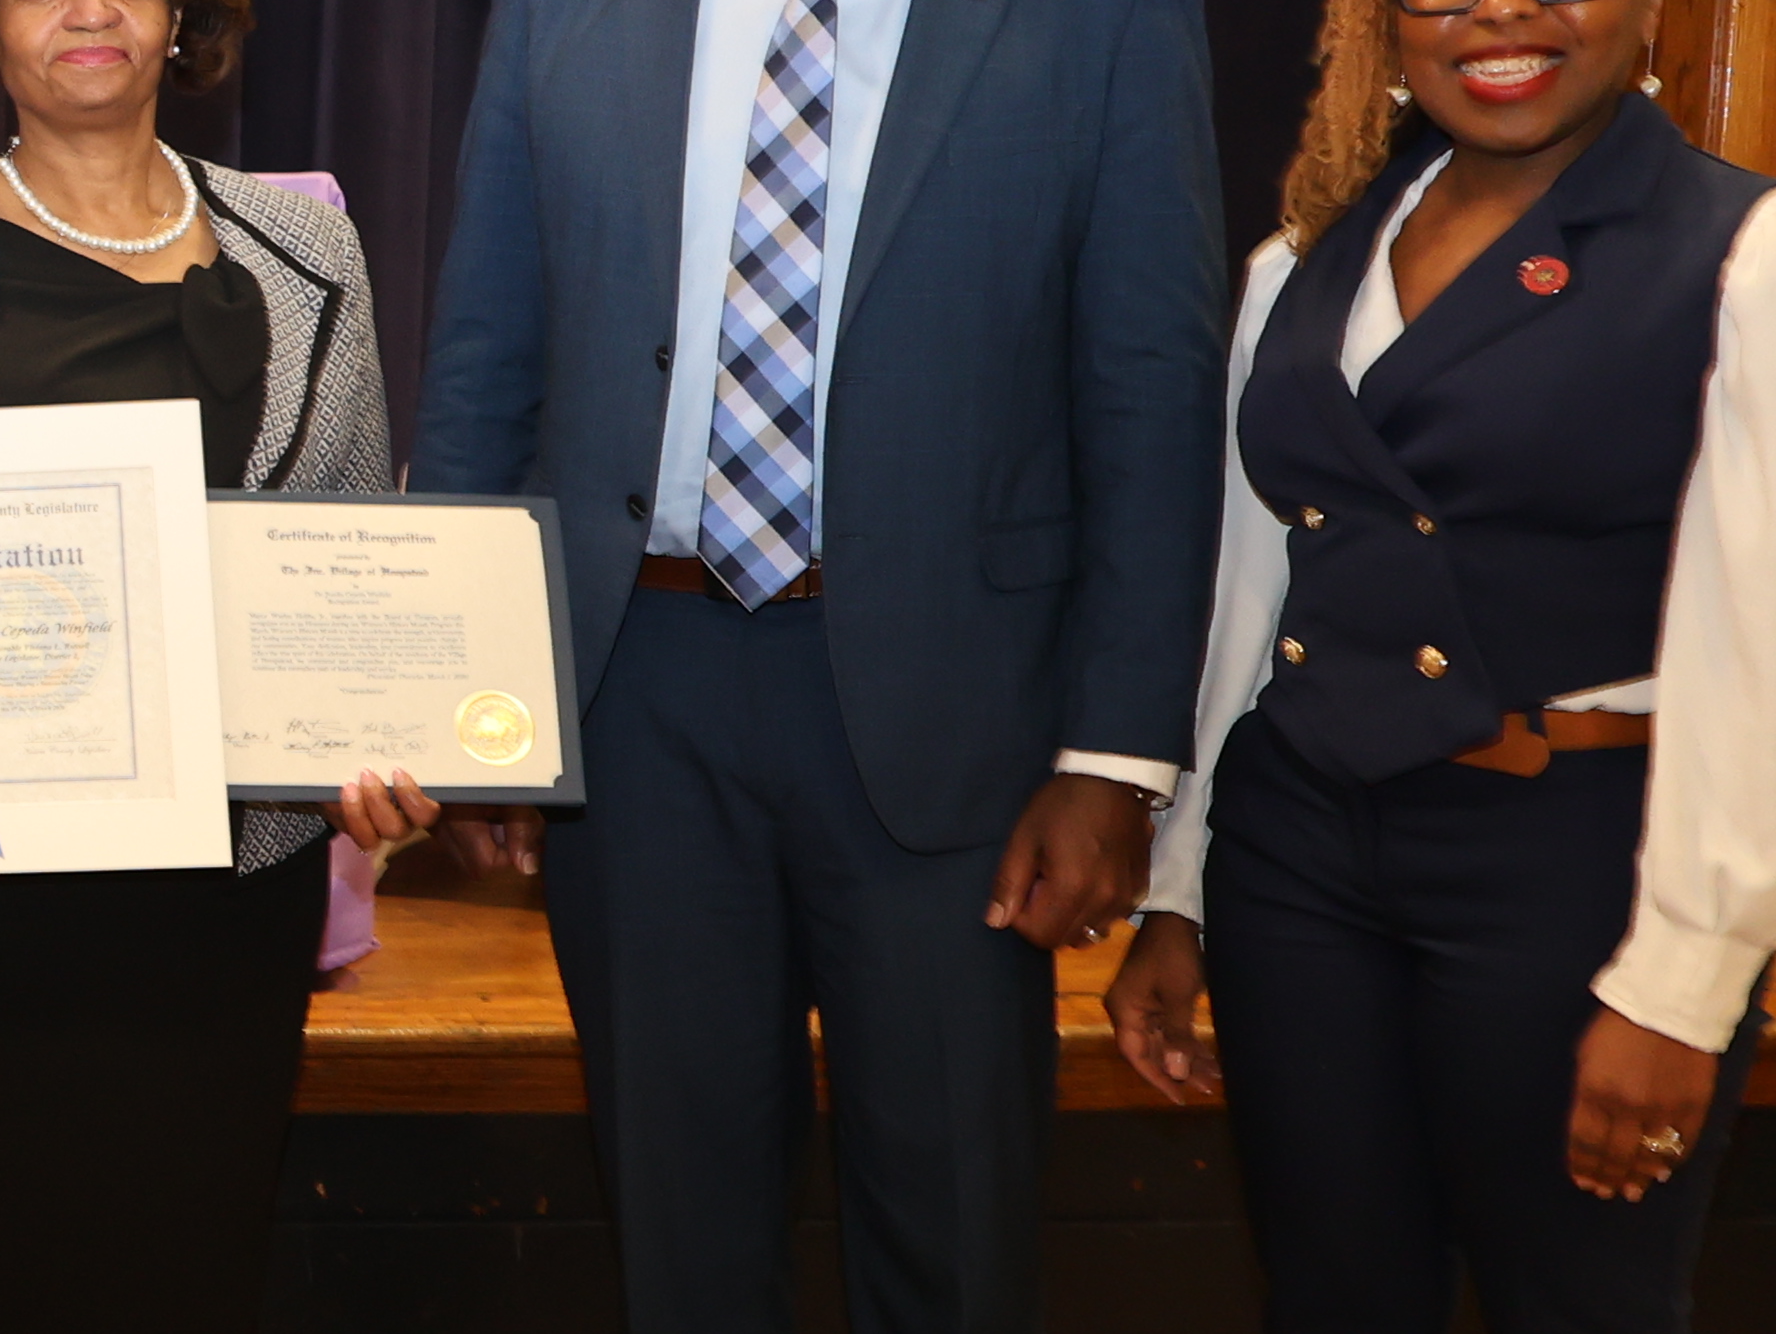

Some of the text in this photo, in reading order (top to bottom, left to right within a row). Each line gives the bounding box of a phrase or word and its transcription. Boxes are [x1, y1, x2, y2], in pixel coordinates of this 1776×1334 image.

[24, 501, 99, 517] Legislature
[267, 529, 437, 547] Certificate of Recognition
[0, 623, 49, 639] Cepeda
[55, 620, 117, 636] Winfield
